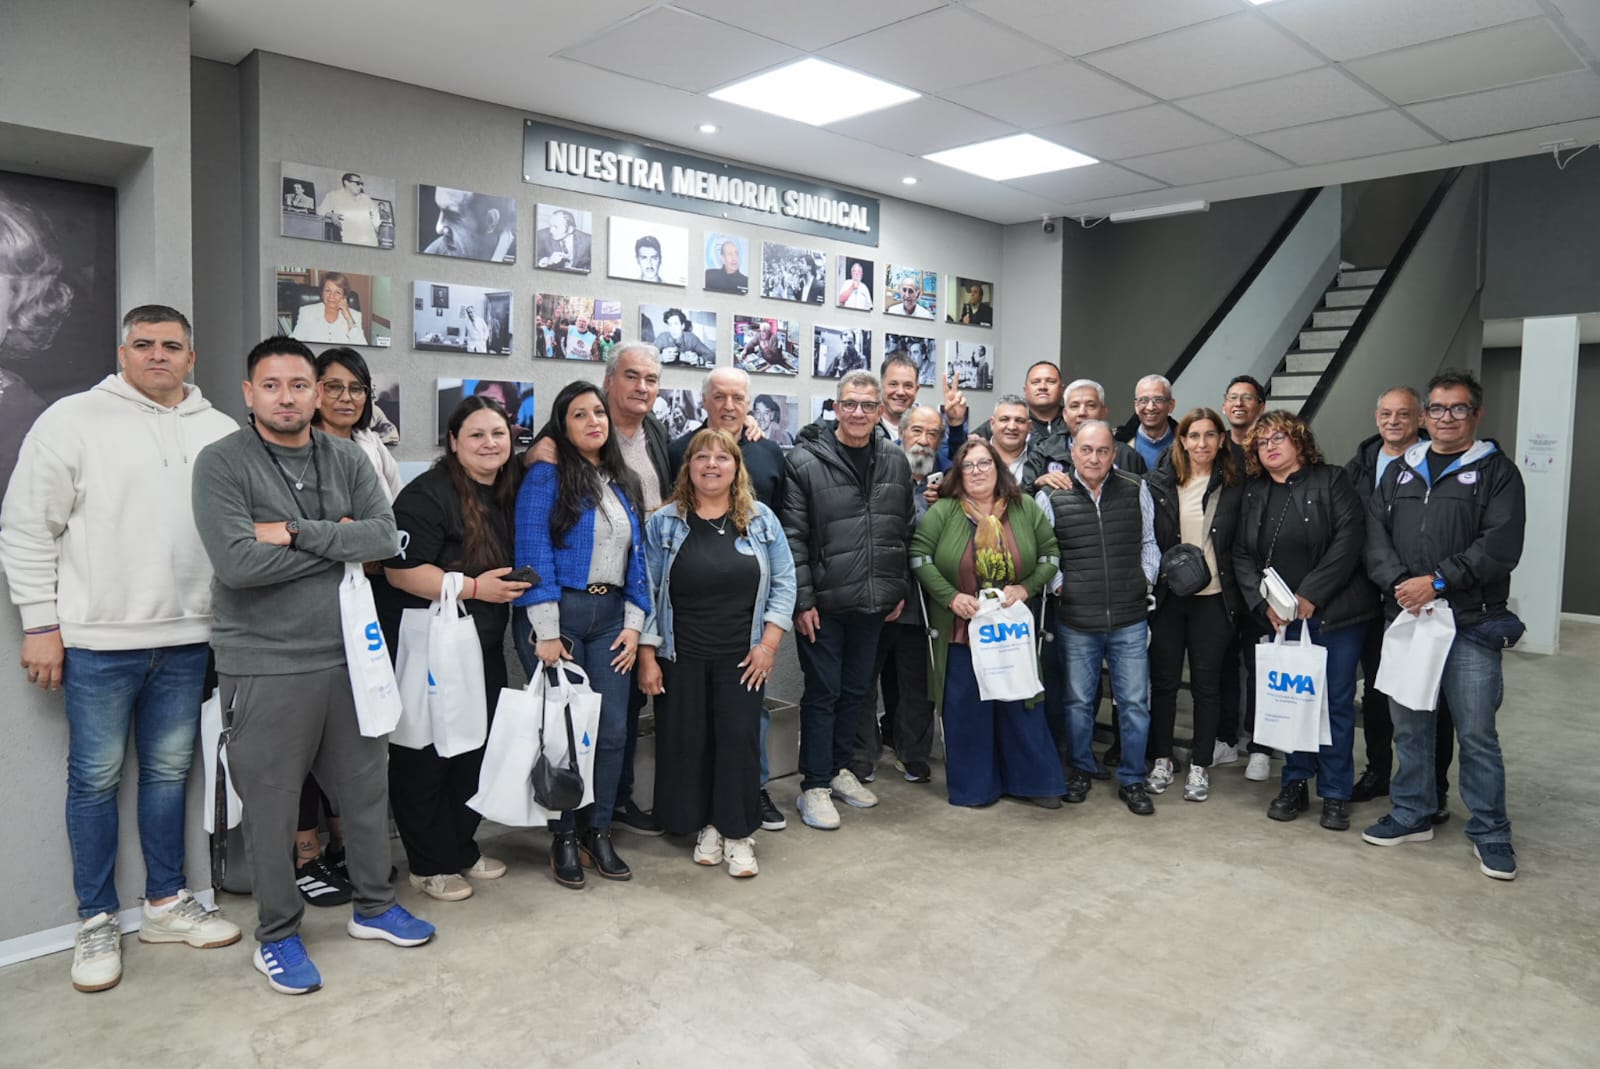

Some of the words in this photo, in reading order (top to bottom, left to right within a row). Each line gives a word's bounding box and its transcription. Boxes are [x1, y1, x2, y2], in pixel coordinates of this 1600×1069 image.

[547, 140, 666, 192] NUESTRA
[671, 165, 779, 214] MEMORIA
[783, 190, 871, 232] SINDICAL
[979, 622, 1030, 643] SUMA
[1268, 670, 1316, 696] SUMA
